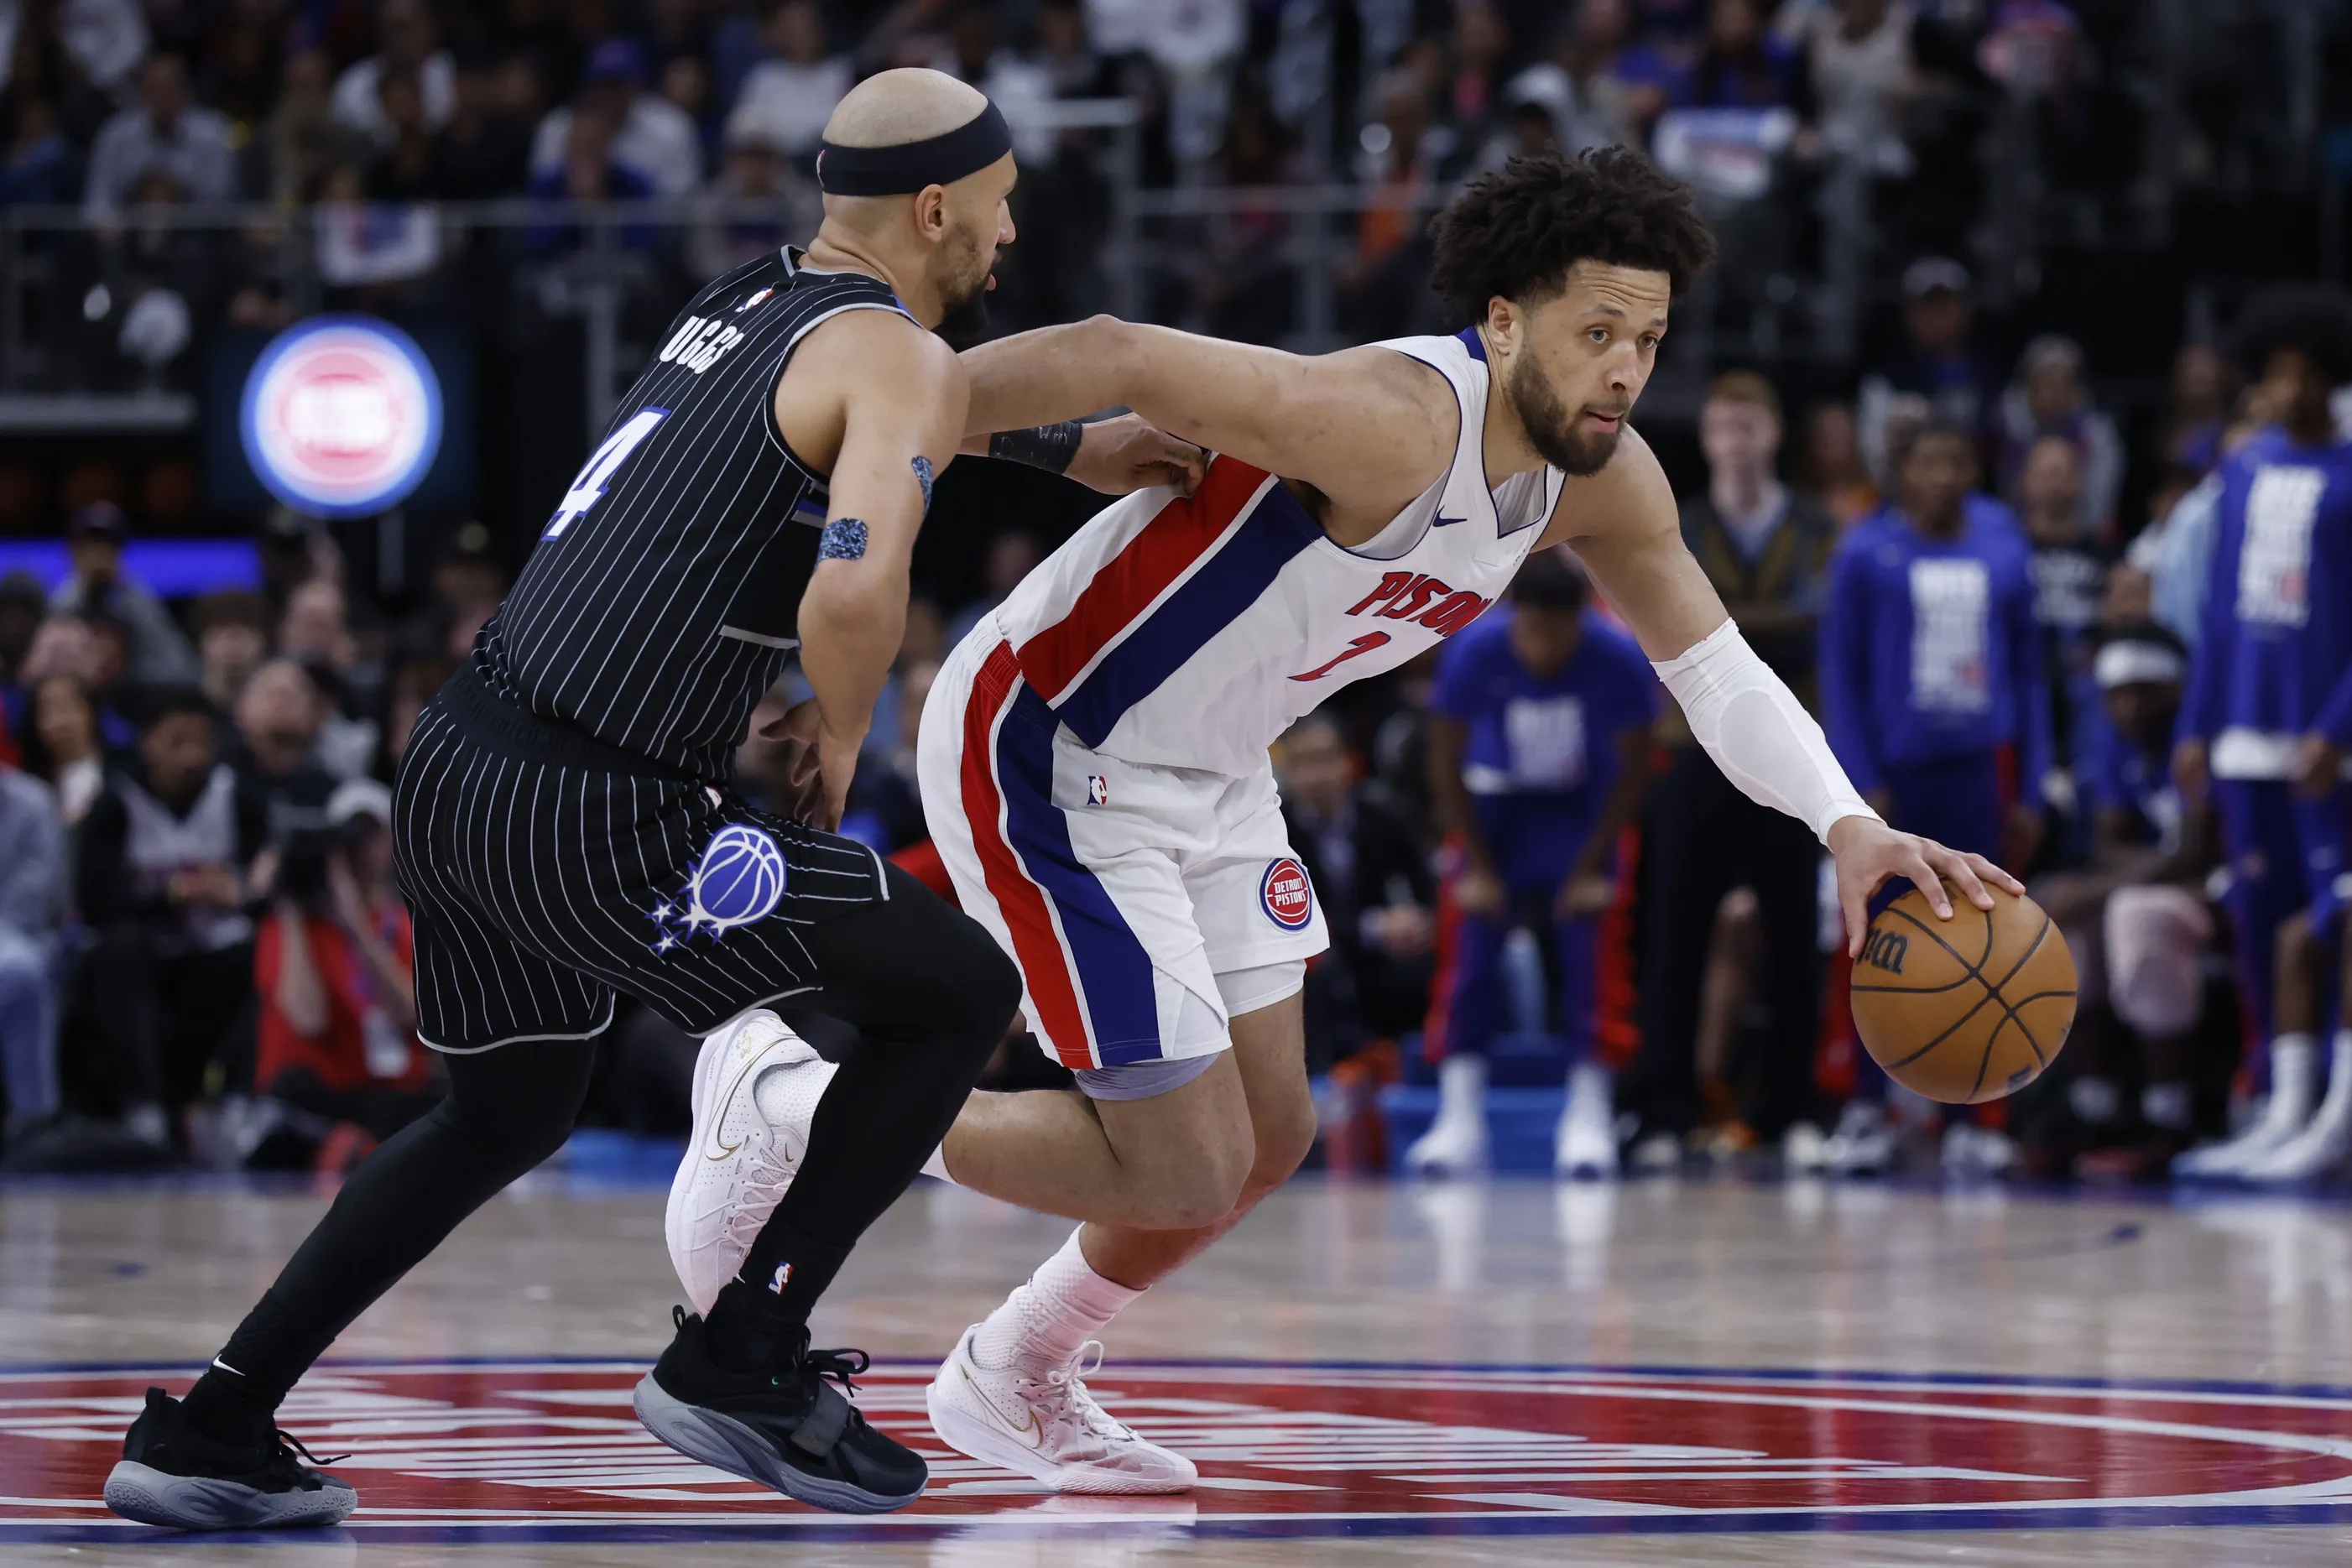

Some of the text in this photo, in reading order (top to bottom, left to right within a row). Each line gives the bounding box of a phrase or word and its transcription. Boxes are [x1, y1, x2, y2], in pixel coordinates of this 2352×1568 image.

[659, 315, 745, 375] UGGS
[541, 406, 671, 542] 4
[1344, 571, 1494, 638] PISTON
[1274, 878, 1302, 893] DETROIT
[1275, 891, 1306, 906] PISTONS
